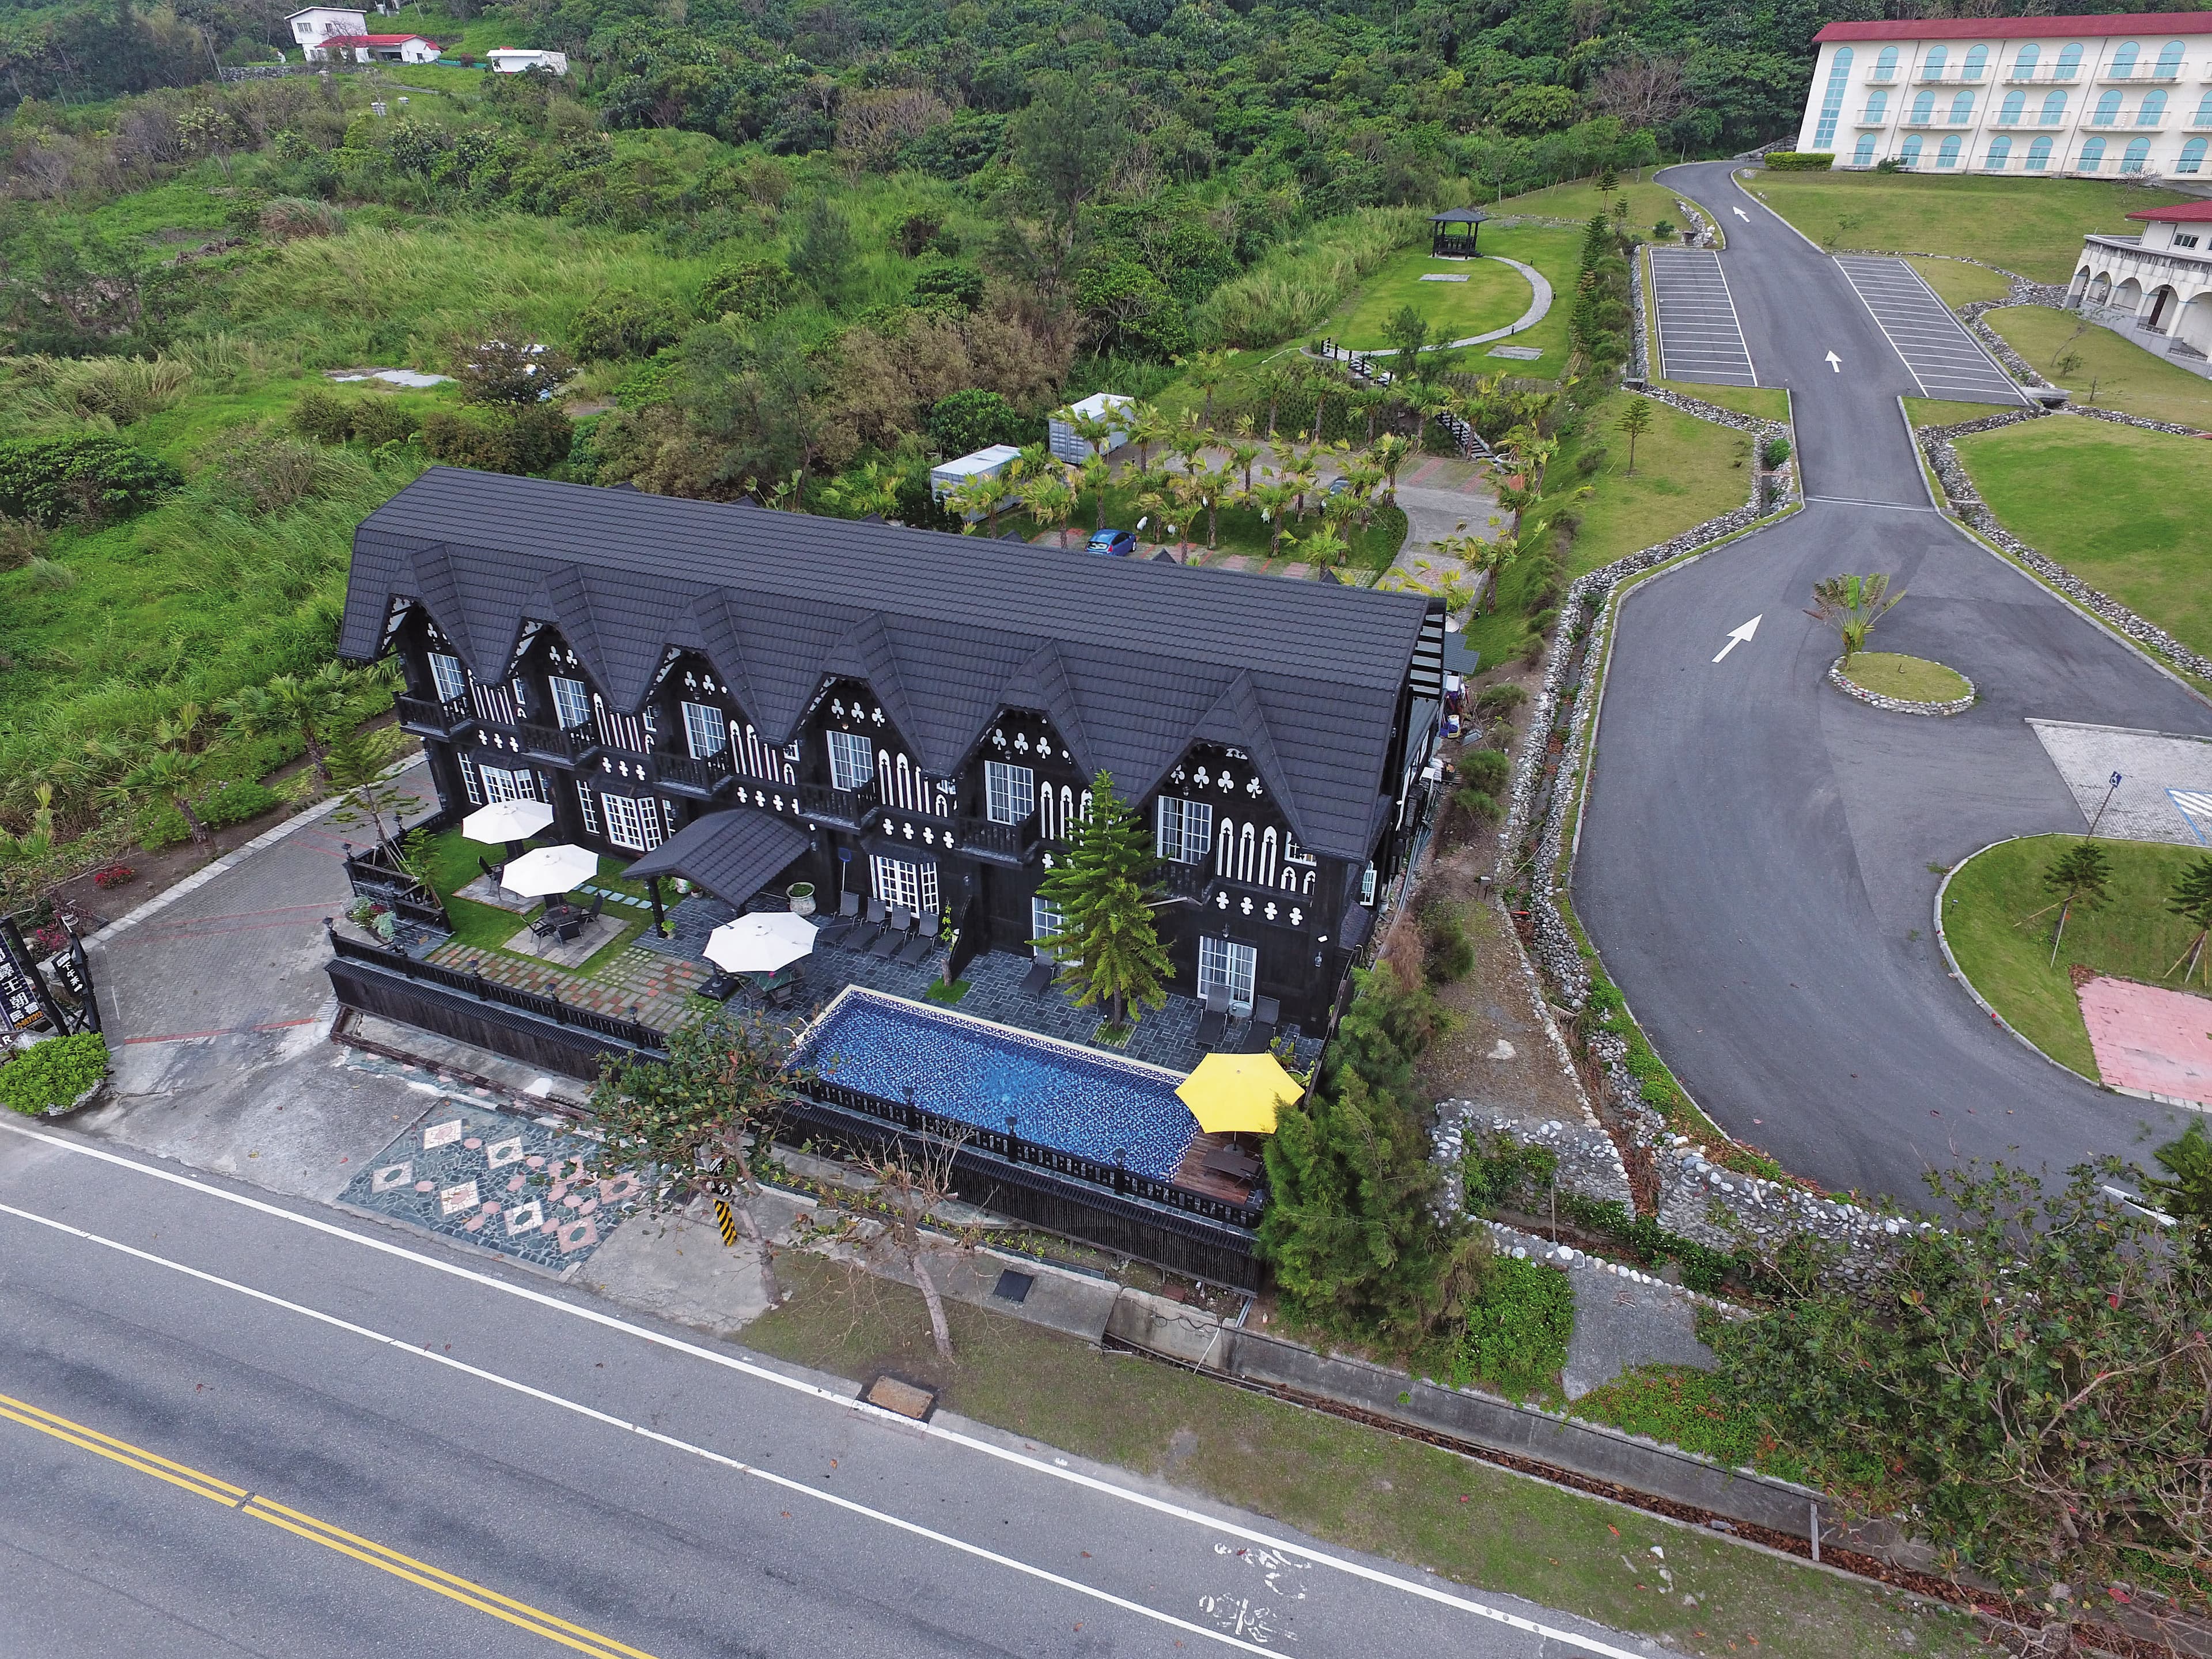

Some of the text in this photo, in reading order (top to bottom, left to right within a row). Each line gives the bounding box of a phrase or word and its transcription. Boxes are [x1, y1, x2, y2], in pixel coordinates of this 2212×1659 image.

[62, 961, 80, 986] 下午茶
[9, 1002, 39, 1022] 民宿
